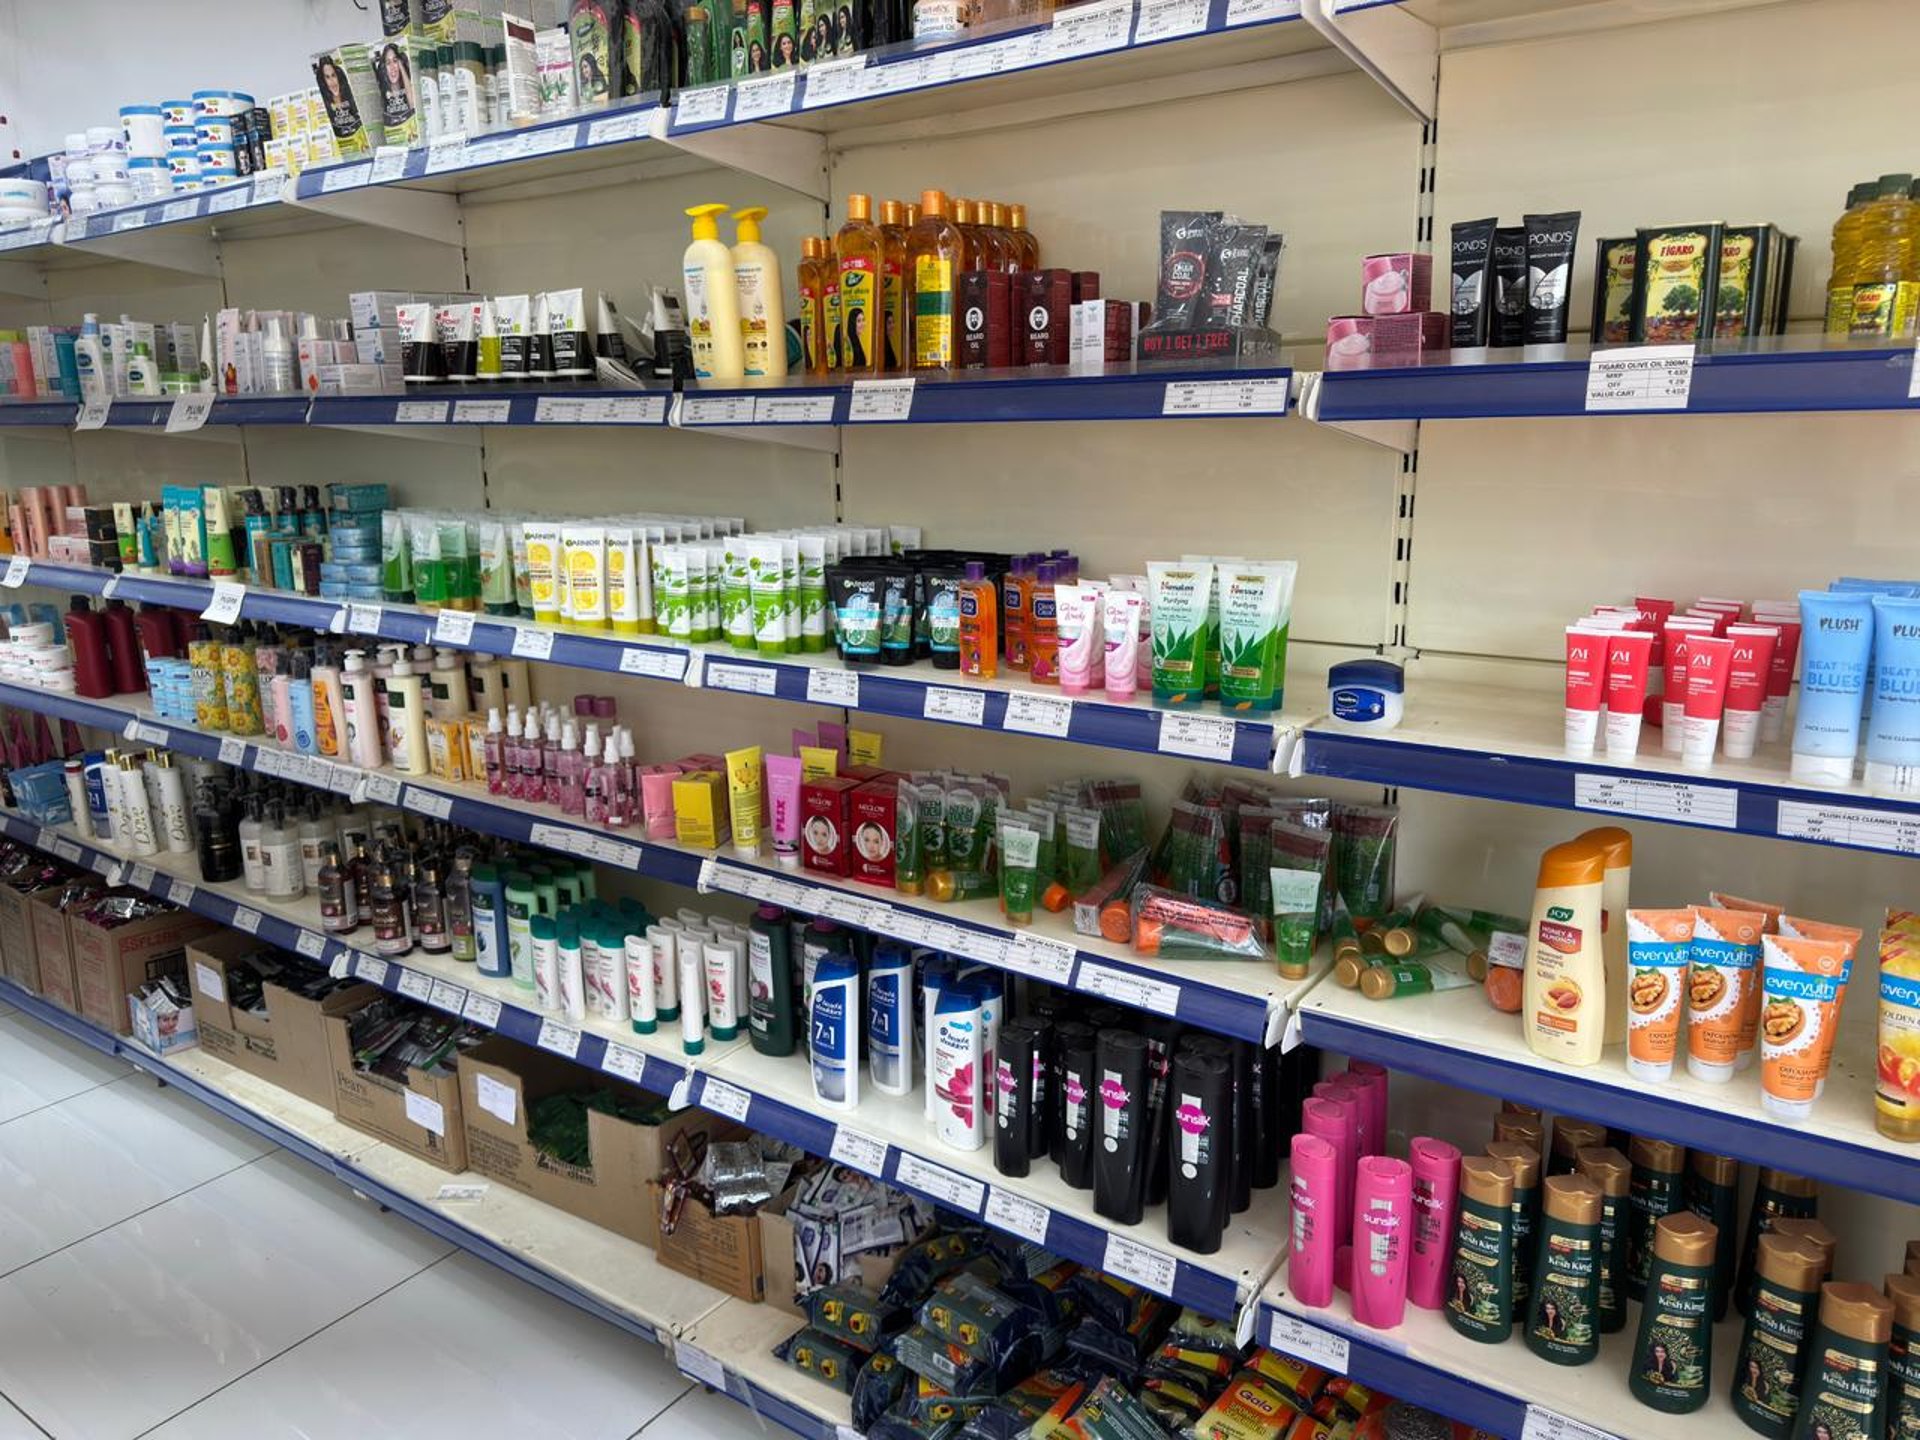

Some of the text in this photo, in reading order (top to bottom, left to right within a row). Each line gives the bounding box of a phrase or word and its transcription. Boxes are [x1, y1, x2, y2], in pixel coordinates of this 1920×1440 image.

[1529, 231, 1572, 246] POND'S
[1453, 239, 1488, 253] POND'S
[1231, 268, 1249, 326] CHARCOAL
[1029, 333, 1050, 342] BEARD
[970, 341, 980, 349] OIL
[1035, 341, 1045, 349] OIL
[1598, 360, 1690, 372] FIGARO OLIVE OIL 200ML
[1591, 390, 1615, 398] VALUE
[1616, 388, 1636, 397] CART
[844, 580, 876, 589] GARNIER
[1819, 617, 1859, 632] PLUSH
[1808, 661, 1834, 670] BEAT
[1880, 668, 1907, 677] BEAT
[1807, 673, 1860, 689] BLUES
[776, 800, 786, 832] PLIX
[1549, 909, 1570, 919] JOY
[1632, 950, 1688, 968] everyuth
[1690, 948, 1751, 969] everyuth
[1766, 976, 1836, 998] everyuth
[1240, 1390, 1272, 1412] Gala
